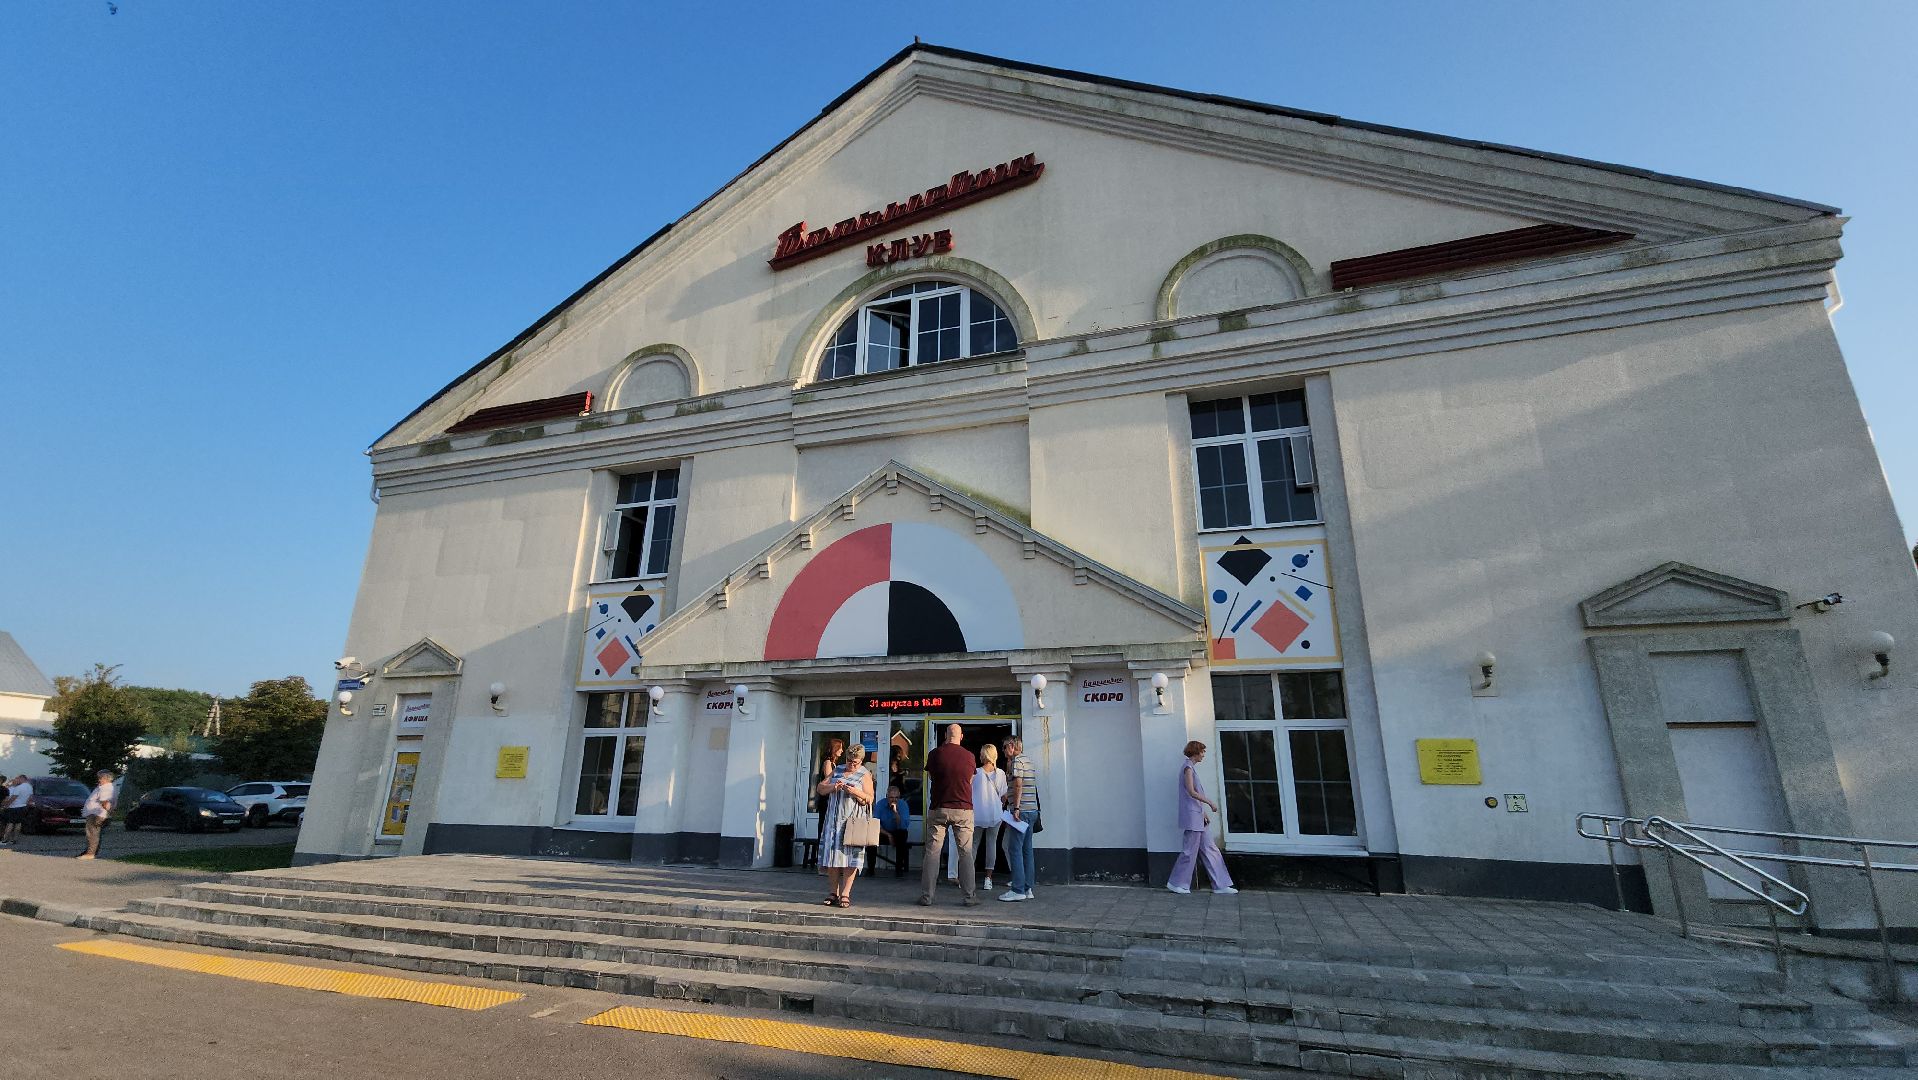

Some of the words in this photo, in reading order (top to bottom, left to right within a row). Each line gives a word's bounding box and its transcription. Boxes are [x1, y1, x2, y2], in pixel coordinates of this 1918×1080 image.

[867, 229, 952, 266] КЛУБ
[1084, 693, 1124, 703] СКОРО
[869, 699, 879, 708] 31
